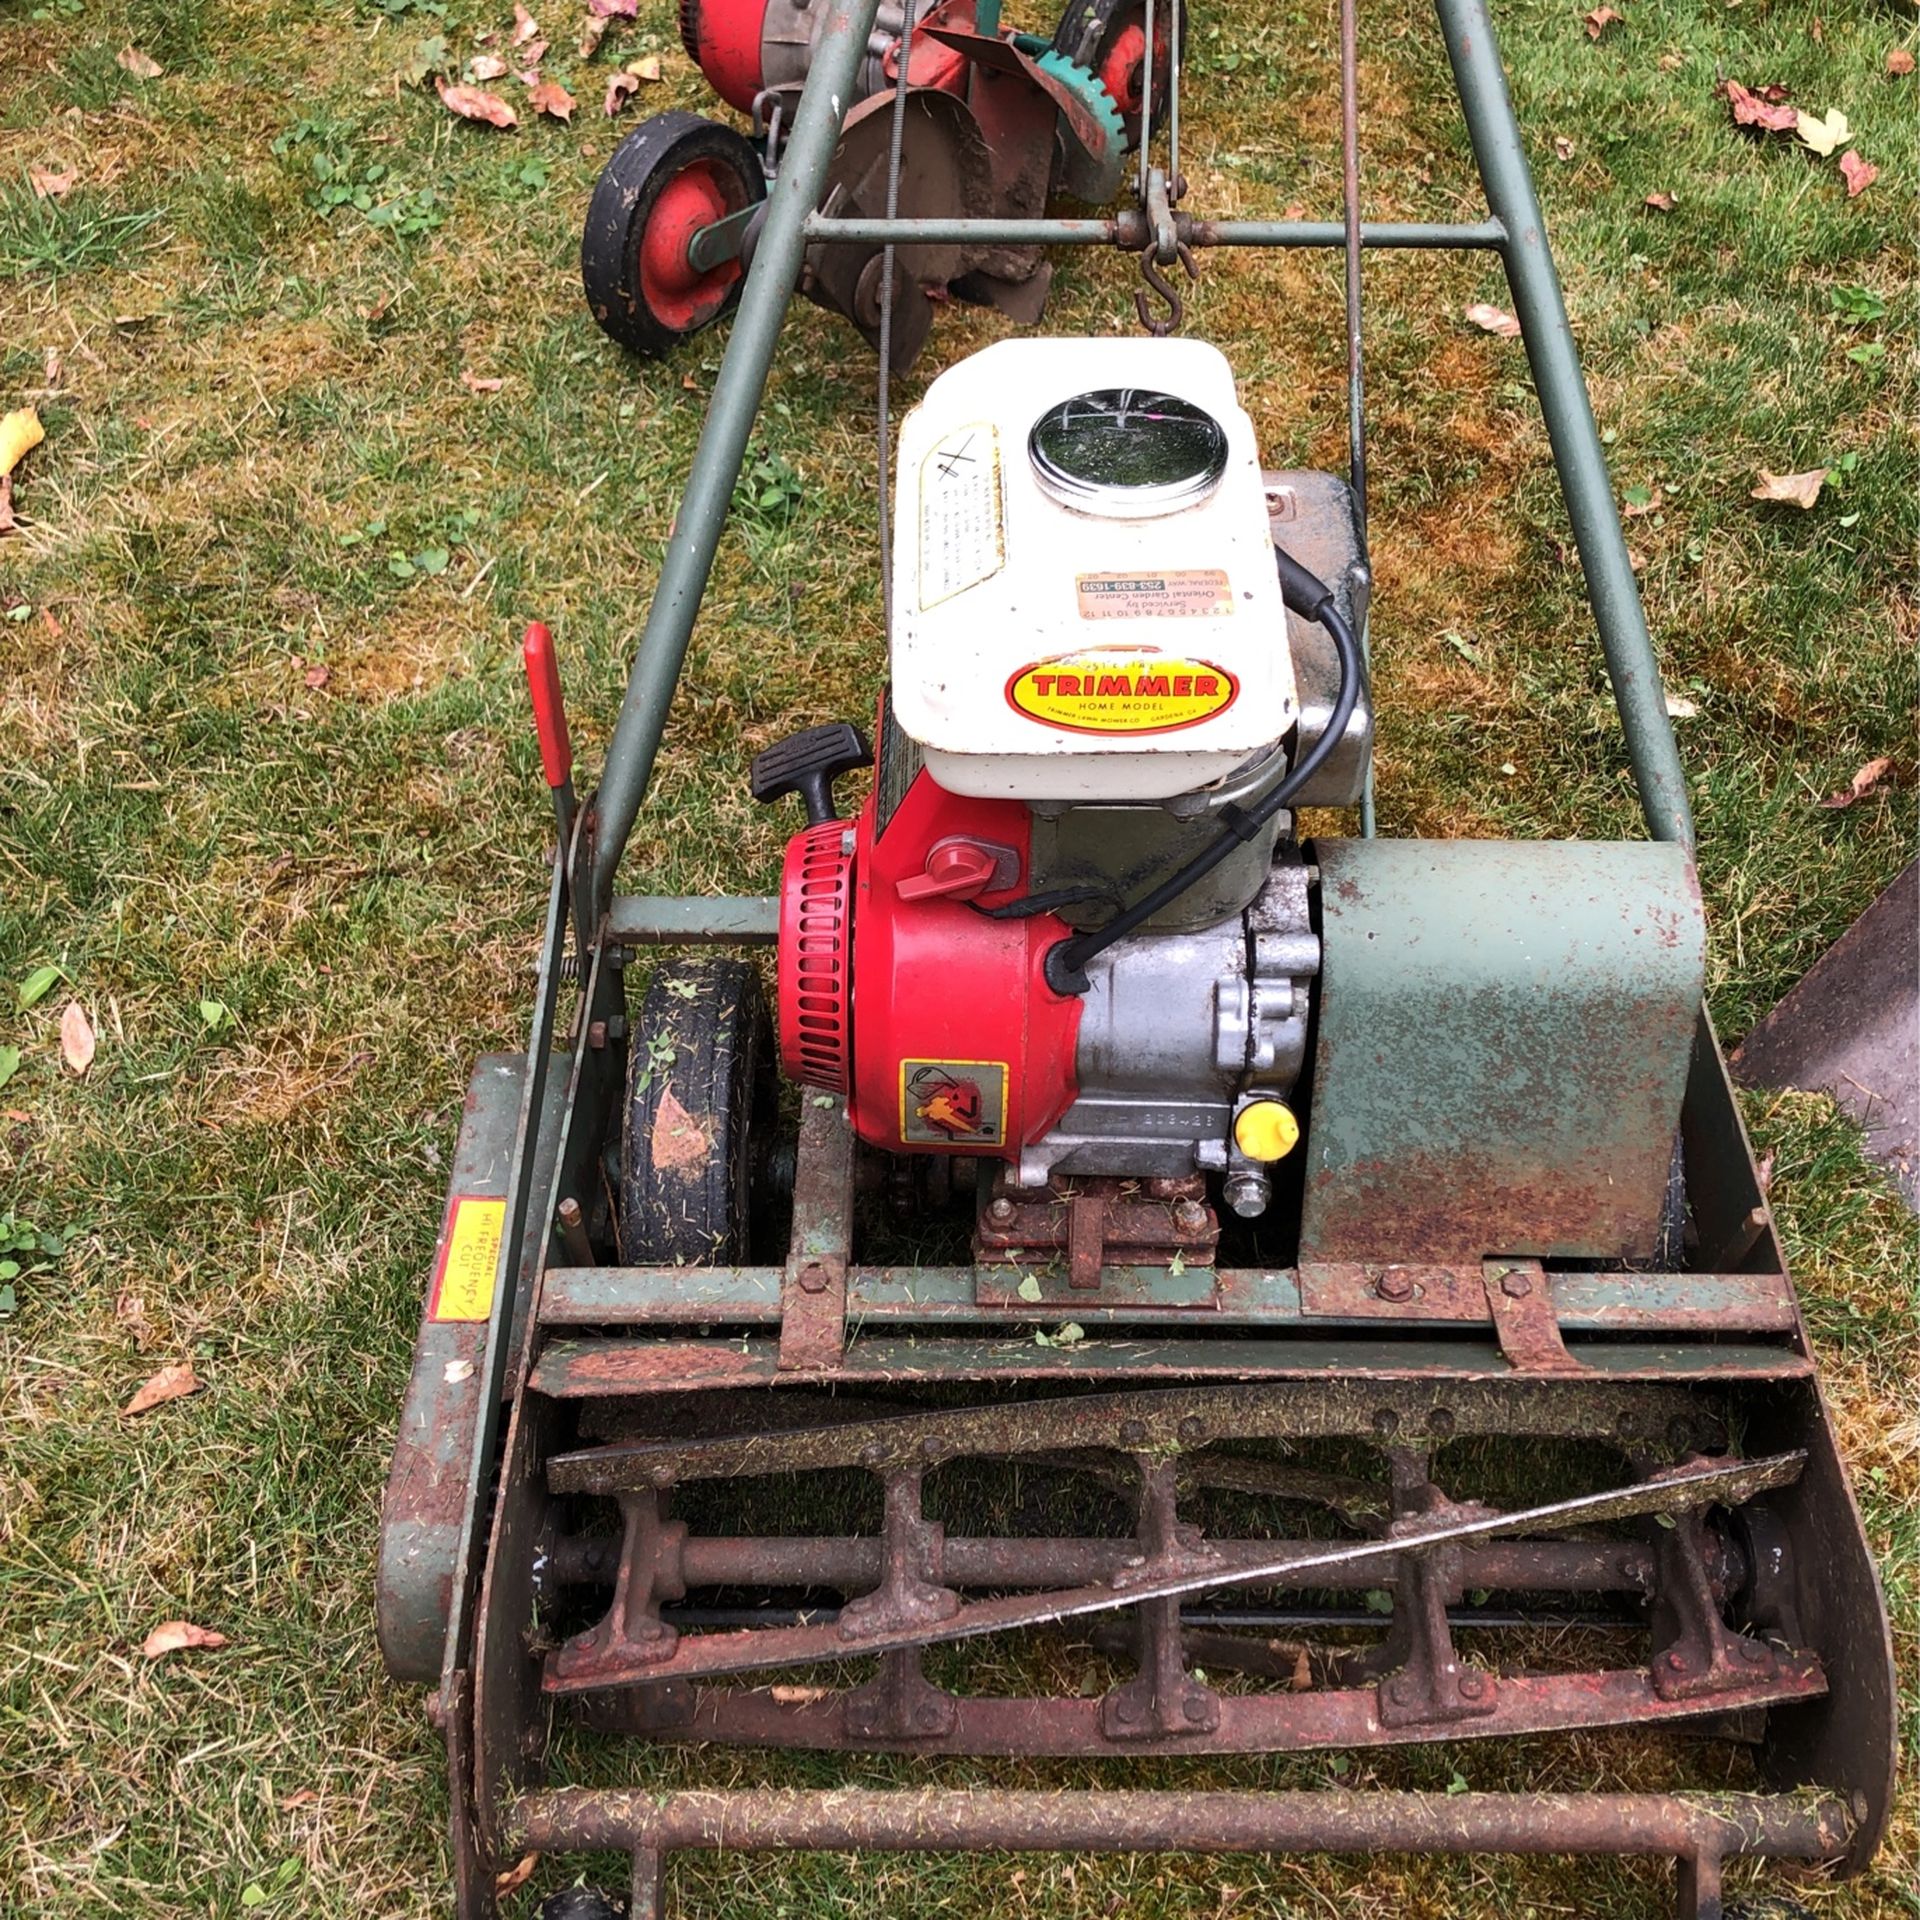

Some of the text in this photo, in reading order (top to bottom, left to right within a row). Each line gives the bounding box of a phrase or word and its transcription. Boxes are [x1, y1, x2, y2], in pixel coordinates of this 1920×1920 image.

[1082, 582, 1161, 591] 253-839-1639
[1126, 600, 1186, 608] Serviced by
[1133, 592, 1169, 600] Garden
[1117, 610, 1128, 618] 10
[1032, 675, 1219, 696] TRIMMER
[1047, 706, 1076, 718] TRIMMER
[1151, 711, 1184, 722] GARDENA
[459, 1245, 473, 1268] CUT
[465, 1213, 492, 1304] HI FREQUENCY
[484, 1237, 499, 1277] SPECIAL
